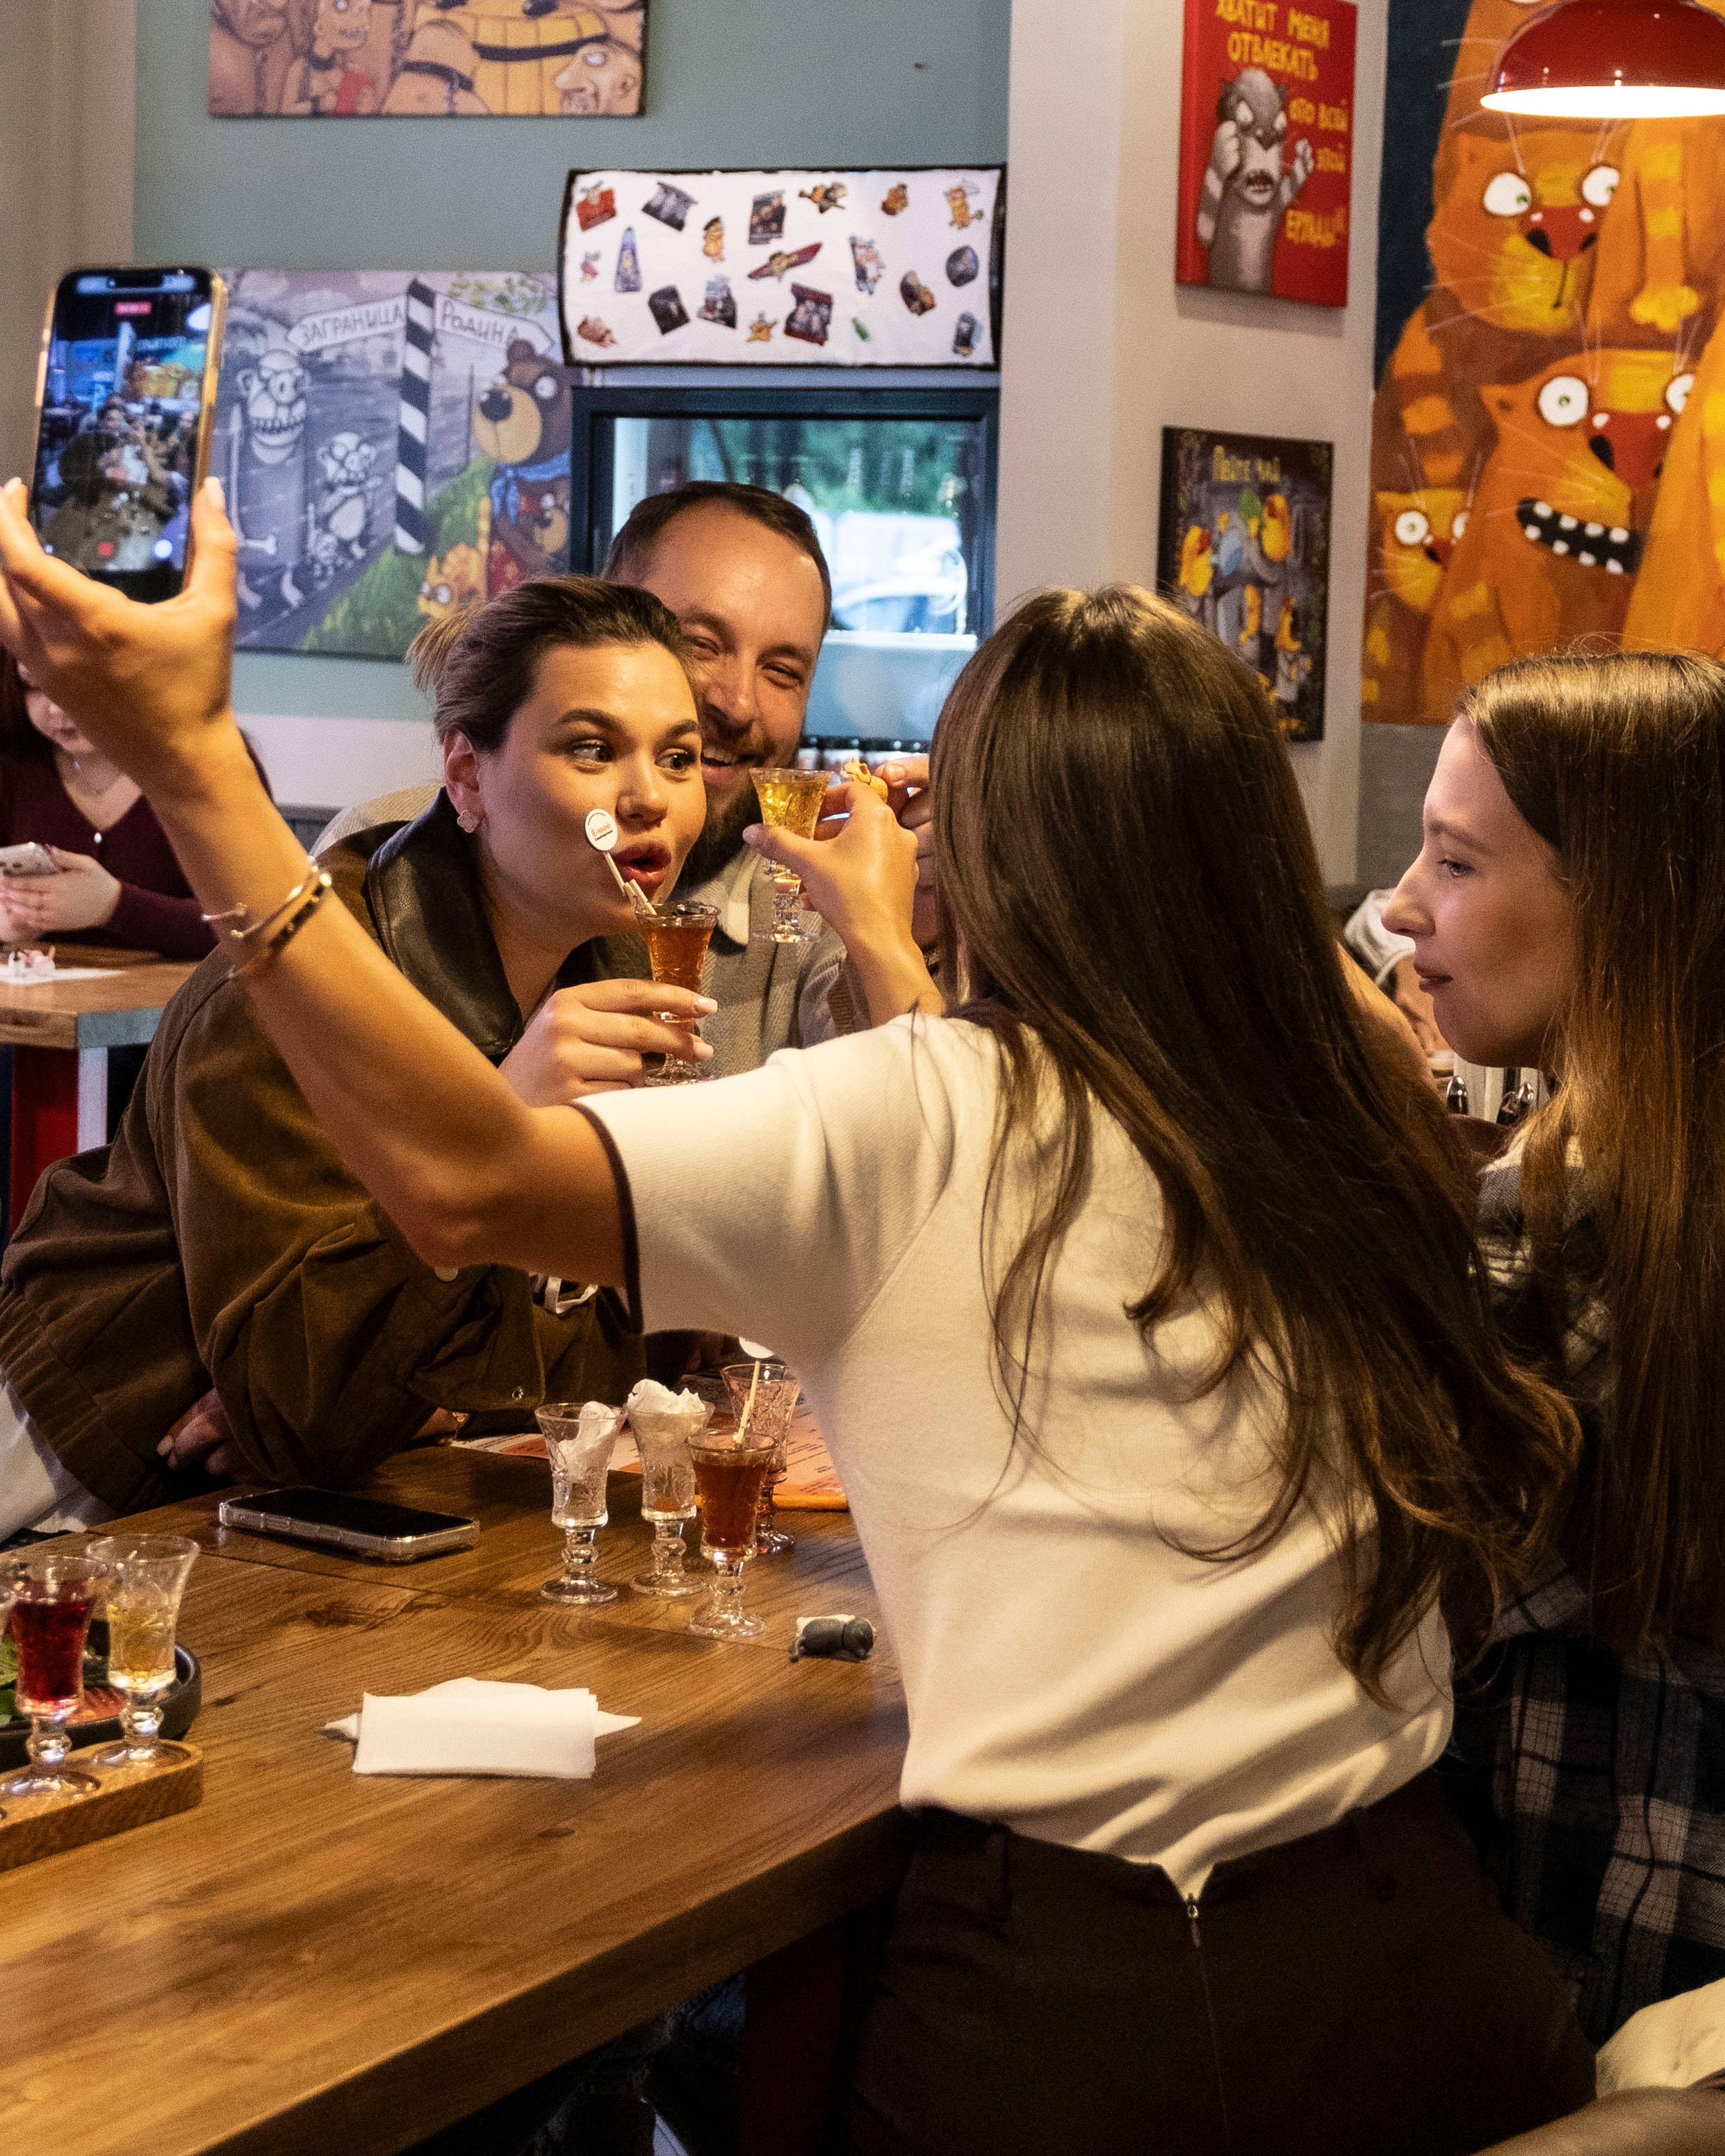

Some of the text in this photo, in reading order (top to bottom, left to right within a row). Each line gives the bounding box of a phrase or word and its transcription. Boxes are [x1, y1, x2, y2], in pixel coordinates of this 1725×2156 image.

[1287, 7, 1330, 49] МЕНЯ
[1227, 31, 1319, 81] ОТВЛЕКАТЬ
[302, 304, 404, 347] ЗАГРАНИЦА
